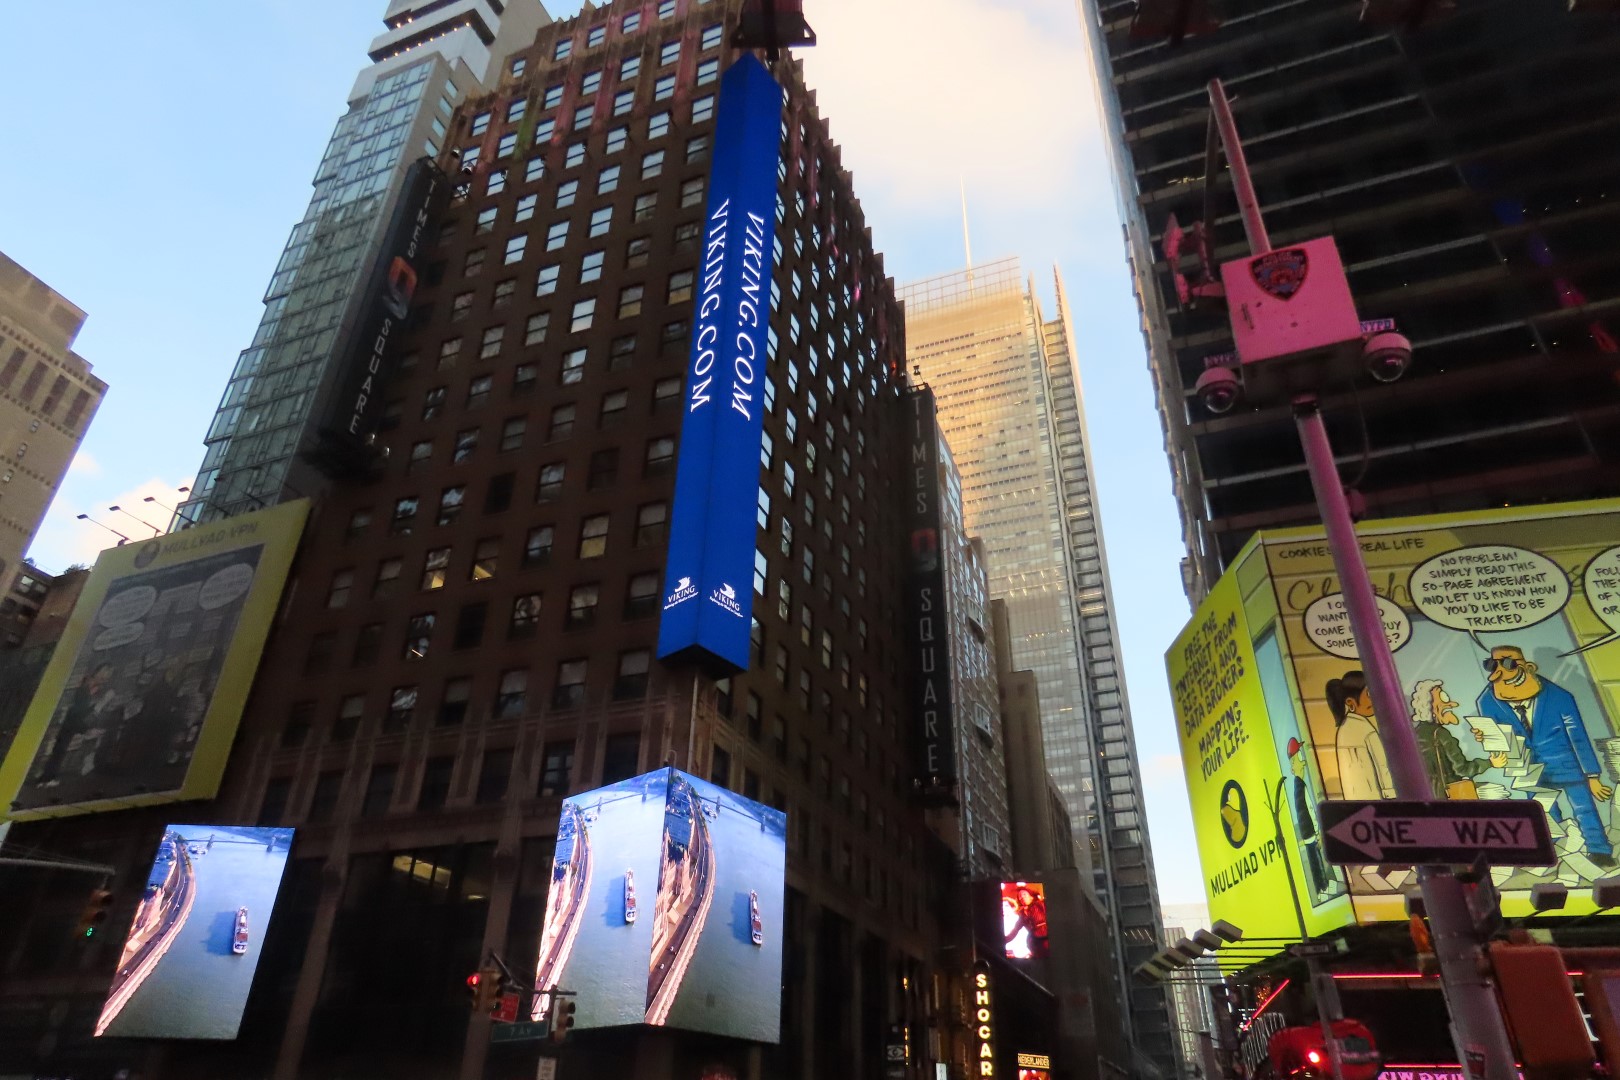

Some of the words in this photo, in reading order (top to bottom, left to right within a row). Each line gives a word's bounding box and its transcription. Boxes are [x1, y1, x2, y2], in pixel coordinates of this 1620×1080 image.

[407, 178, 437, 258] TIMES
[690, 198, 730, 413] VIKING.COM
[731, 211, 764, 421] VIKING.COM
[349, 317, 392, 435] SQUARE
[912, 396, 927, 514] TIMES
[1393, 538, 1424, 550] LIFE
[1440, 557, 1457, 567] NO
[1459, 551, 1518, 565] PROBLEM!
[667, 584, 696, 603] VIKING
[1421, 595, 1444, 606] AND
[1447, 592, 1469, 604] LET
[1473, 591, 1489, 601] US
[1492, 587, 1527, 599] KNOW
[1530, 584, 1557, 595] HOW
[1422, 579, 1473, 592] 50-PAGE
[1477, 572, 1547, 588] AGREEMENT
[1429, 568, 1471, 579] SIMPLY
[1475, 565, 1506, 575] READ
[1508, 561, 1536, 572] THIS
[713, 589, 740, 612] VIKING
[1443, 602, 1479, 616] YOU'D
[1482, 601, 1510, 612] LIKE
[1513, 600, 1527, 610] TO
[1530, 598, 1546, 609] BE
[1465, 613, 1527, 627] TRACKED.
[1184, 630, 1200, 667] FREE
[1202, 611, 1217, 641] THE
[1315, 625, 1345, 636] COME
[919, 587, 938, 773] SQUARE
[1176, 641, 1211, 702] INTERNET
[1214, 611, 1236, 653] FROM
[1182, 688, 1197, 717] BIG
[1197, 663, 1217, 697] TECH
[1219, 639, 1237, 673] AND
[1185, 702, 1205, 738] DATA
[1205, 655, 1244, 715] BROKERS
[1198, 700, 1242, 760] MAPPING
[1201, 745, 1225, 782] YOUR
[1224, 720, 1249, 760] LIFE.
[1350, 819, 1416, 846] ONE
[1453, 819, 1523, 844] WAY
[1210, 851, 1259, 898] MULLVAD
